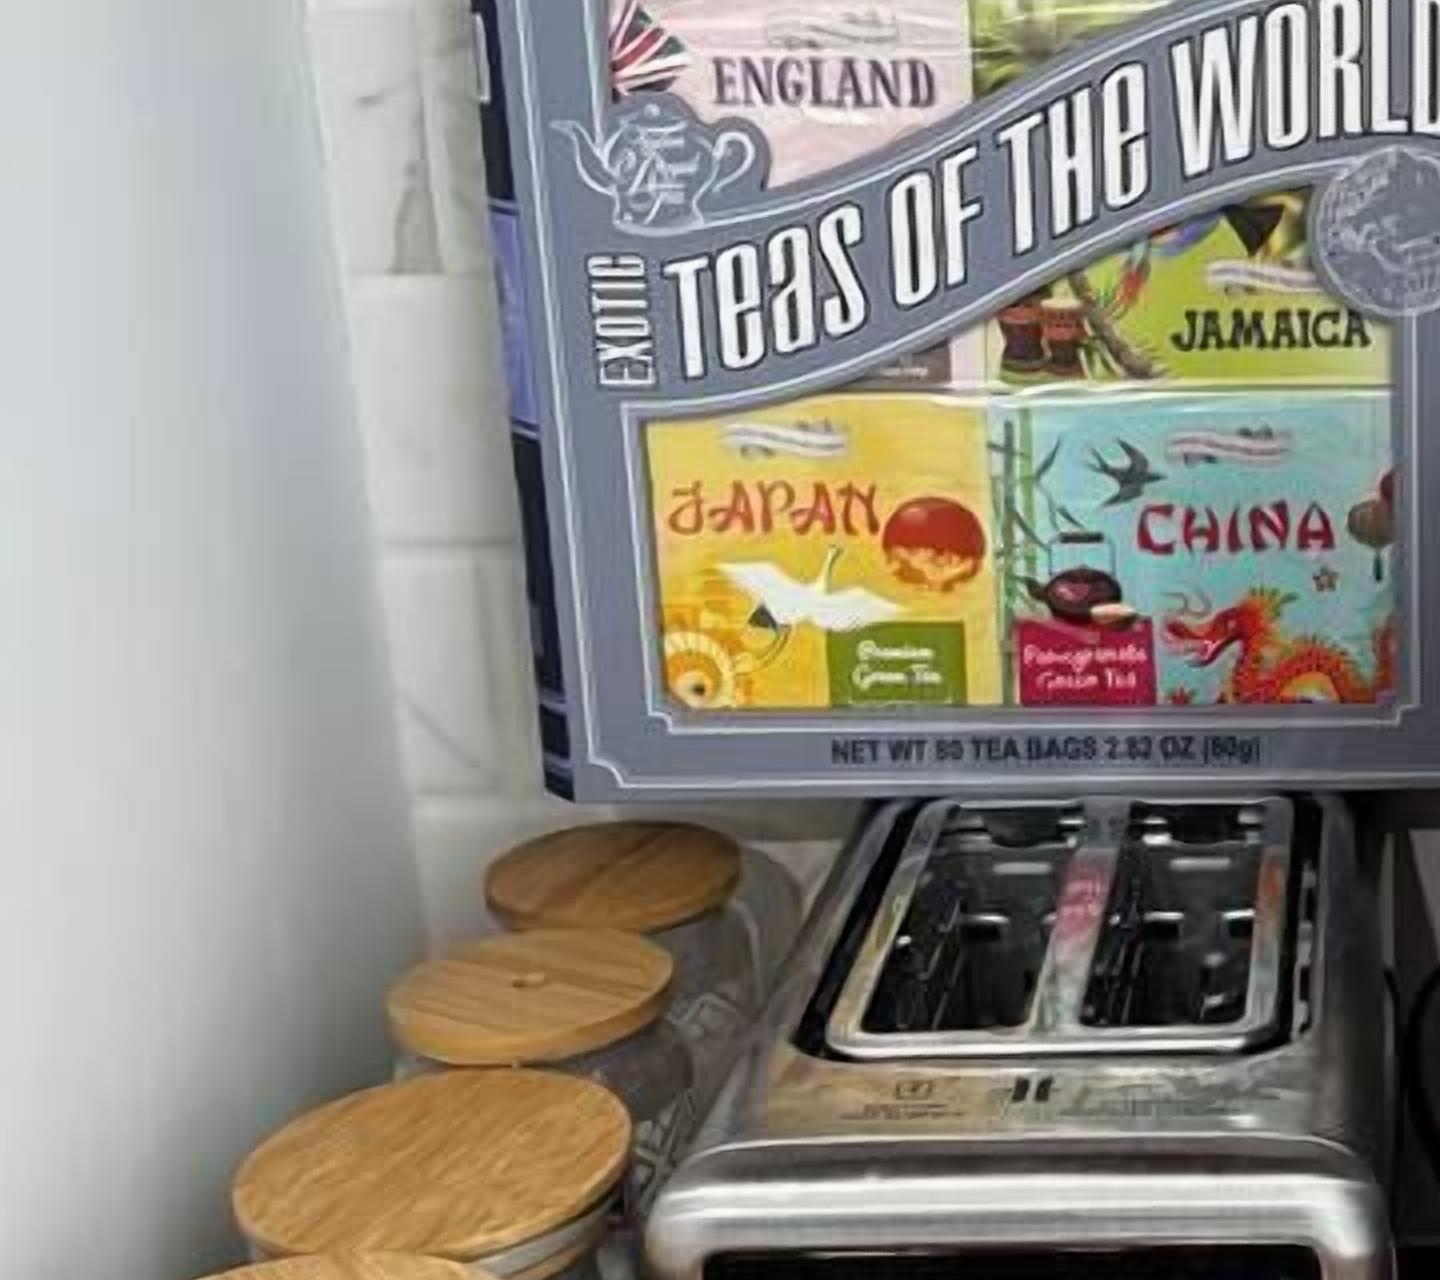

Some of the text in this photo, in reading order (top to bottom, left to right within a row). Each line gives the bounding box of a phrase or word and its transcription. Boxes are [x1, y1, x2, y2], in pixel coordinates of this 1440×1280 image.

[712, 55, 937, 108] ENGLAND
[885, 144, 984, 311] OF
[587, 252, 657, 389] EXOTIC
[1171, 308, 1372, 352] JAMAICA
[668, 479, 882, 537] JAPAN
[1136, 500, 1336, 555] CHINA
[831, 739, 879, 764] NET
[888, 738, 928, 762] WT
[973, 736, 1020, 761] TEA
[1027, 736, 1097, 762] BAGS
[1159, 735, 1196, 761] OZ
